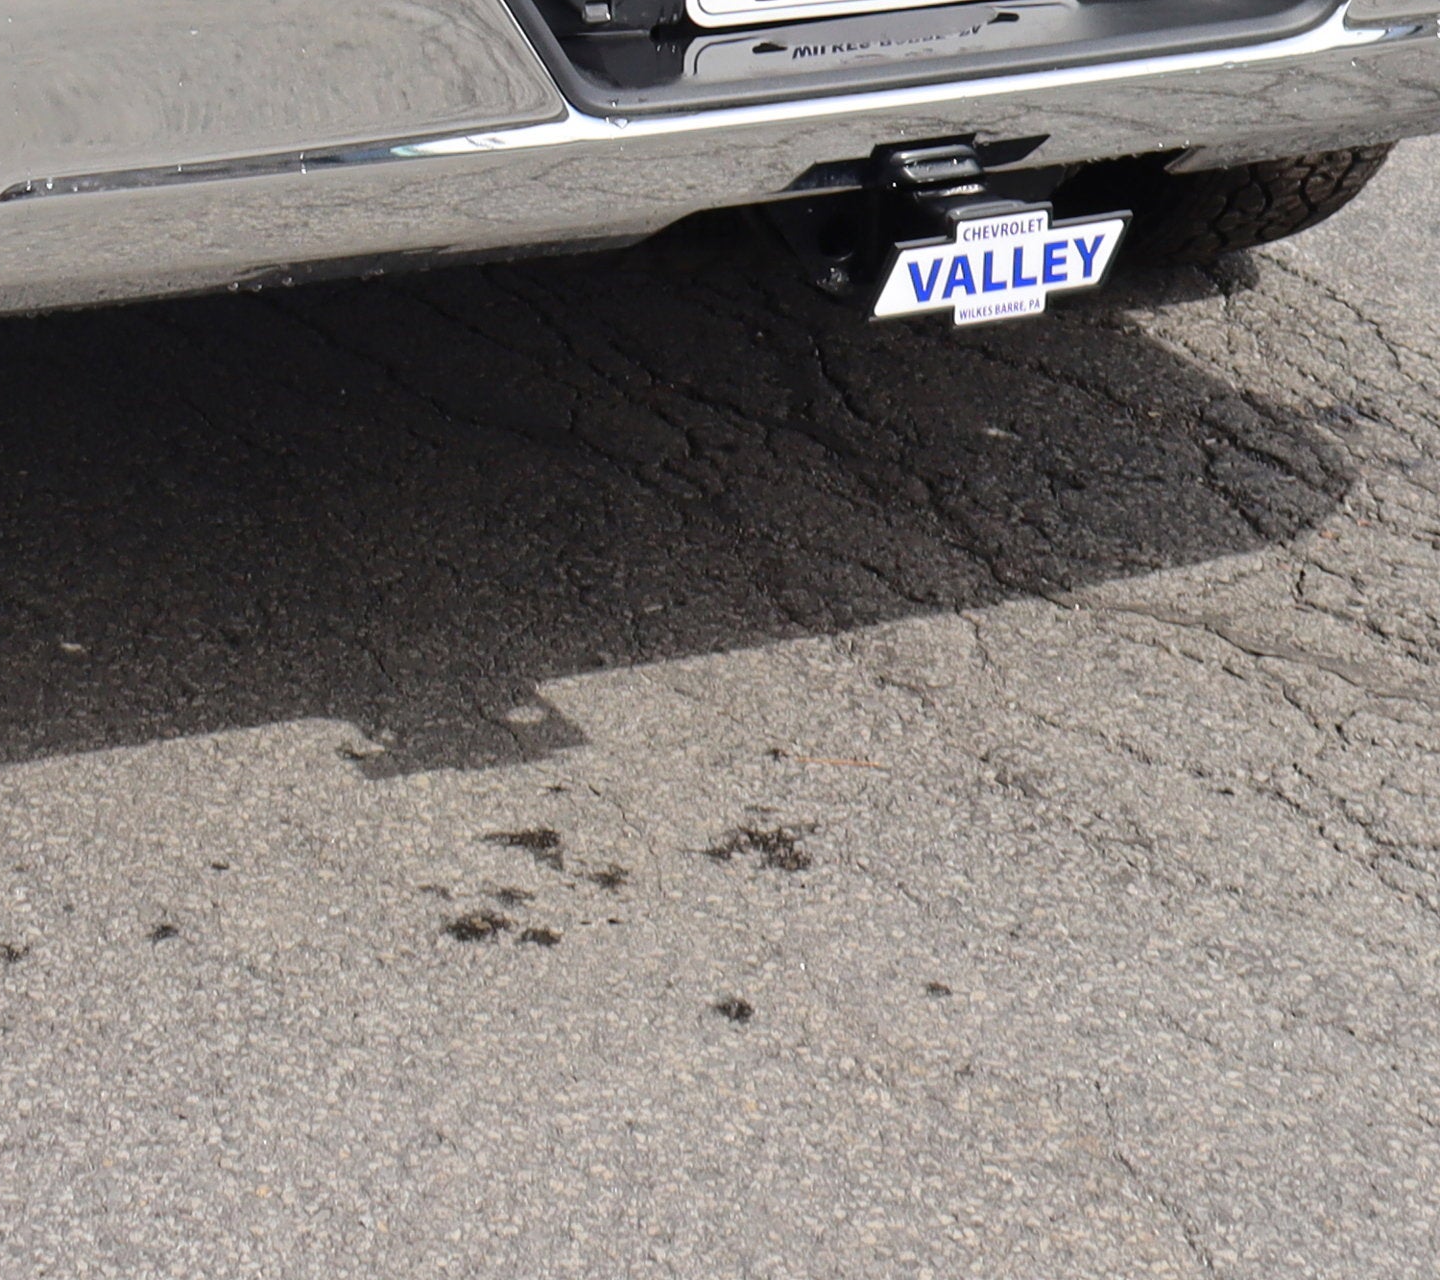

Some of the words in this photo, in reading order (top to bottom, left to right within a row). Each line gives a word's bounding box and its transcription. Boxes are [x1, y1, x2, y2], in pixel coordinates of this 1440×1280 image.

[962, 218, 1045, 243] CHEVROLET
[908, 233, 1106, 304] VALLEY
[958, 304, 994, 321] WILKES
[994, 300, 1027, 317] BARRE,
[1028, 298, 1041, 310] PA
